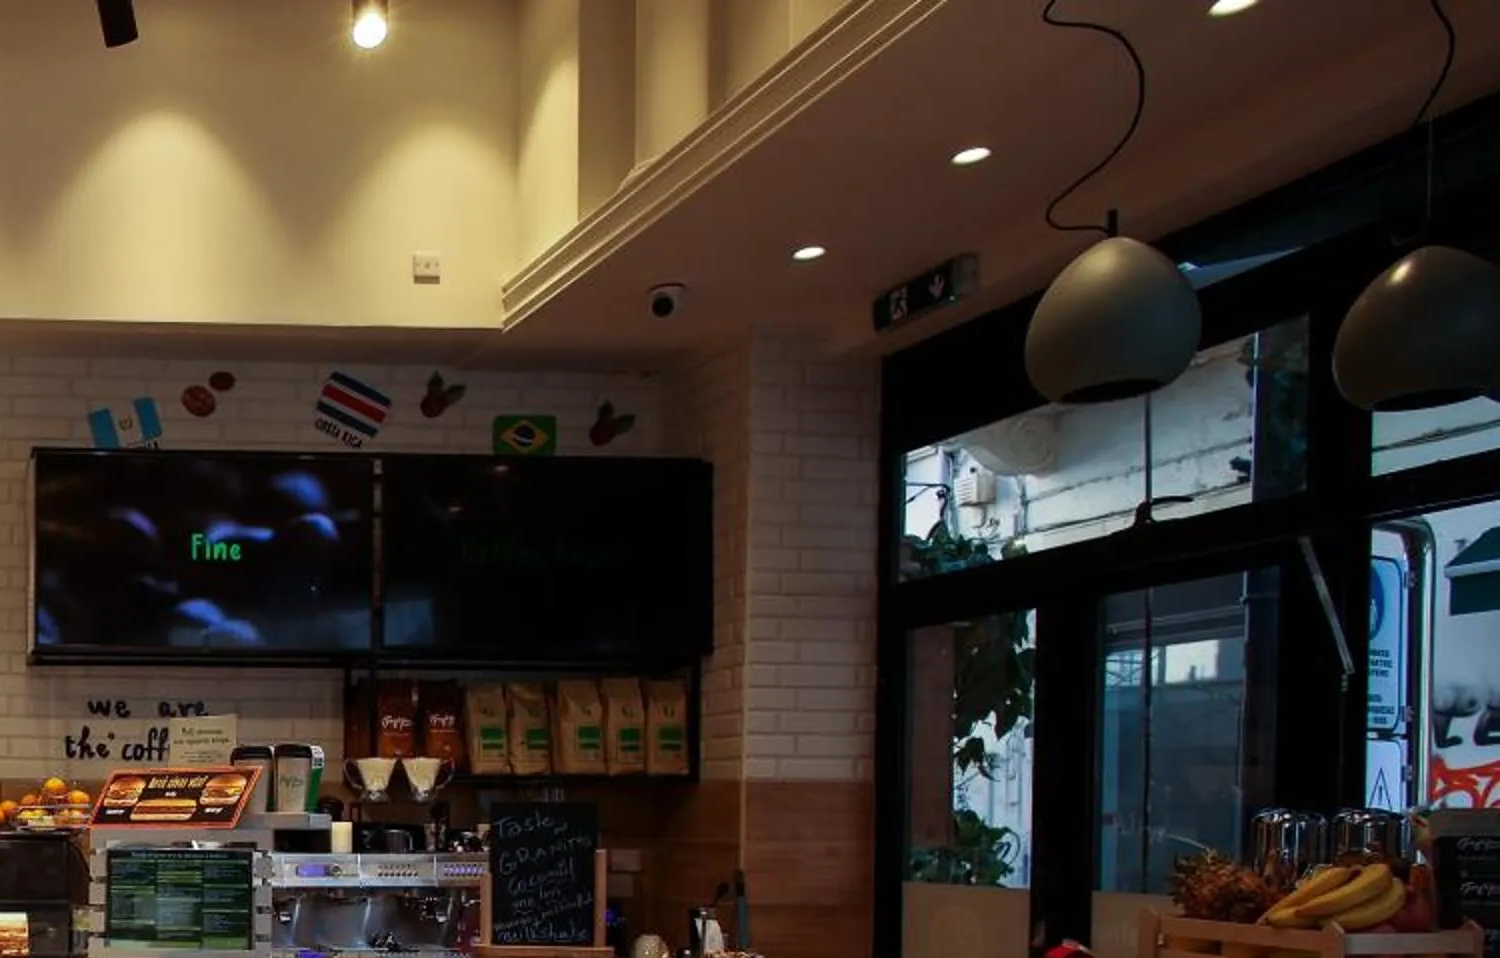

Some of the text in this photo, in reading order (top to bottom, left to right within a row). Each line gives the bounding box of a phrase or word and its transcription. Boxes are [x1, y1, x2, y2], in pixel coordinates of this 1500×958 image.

[190, 532, 242, 561] Fine
[88, 700, 209, 718] we are
[121, 726, 170, 762] coff
